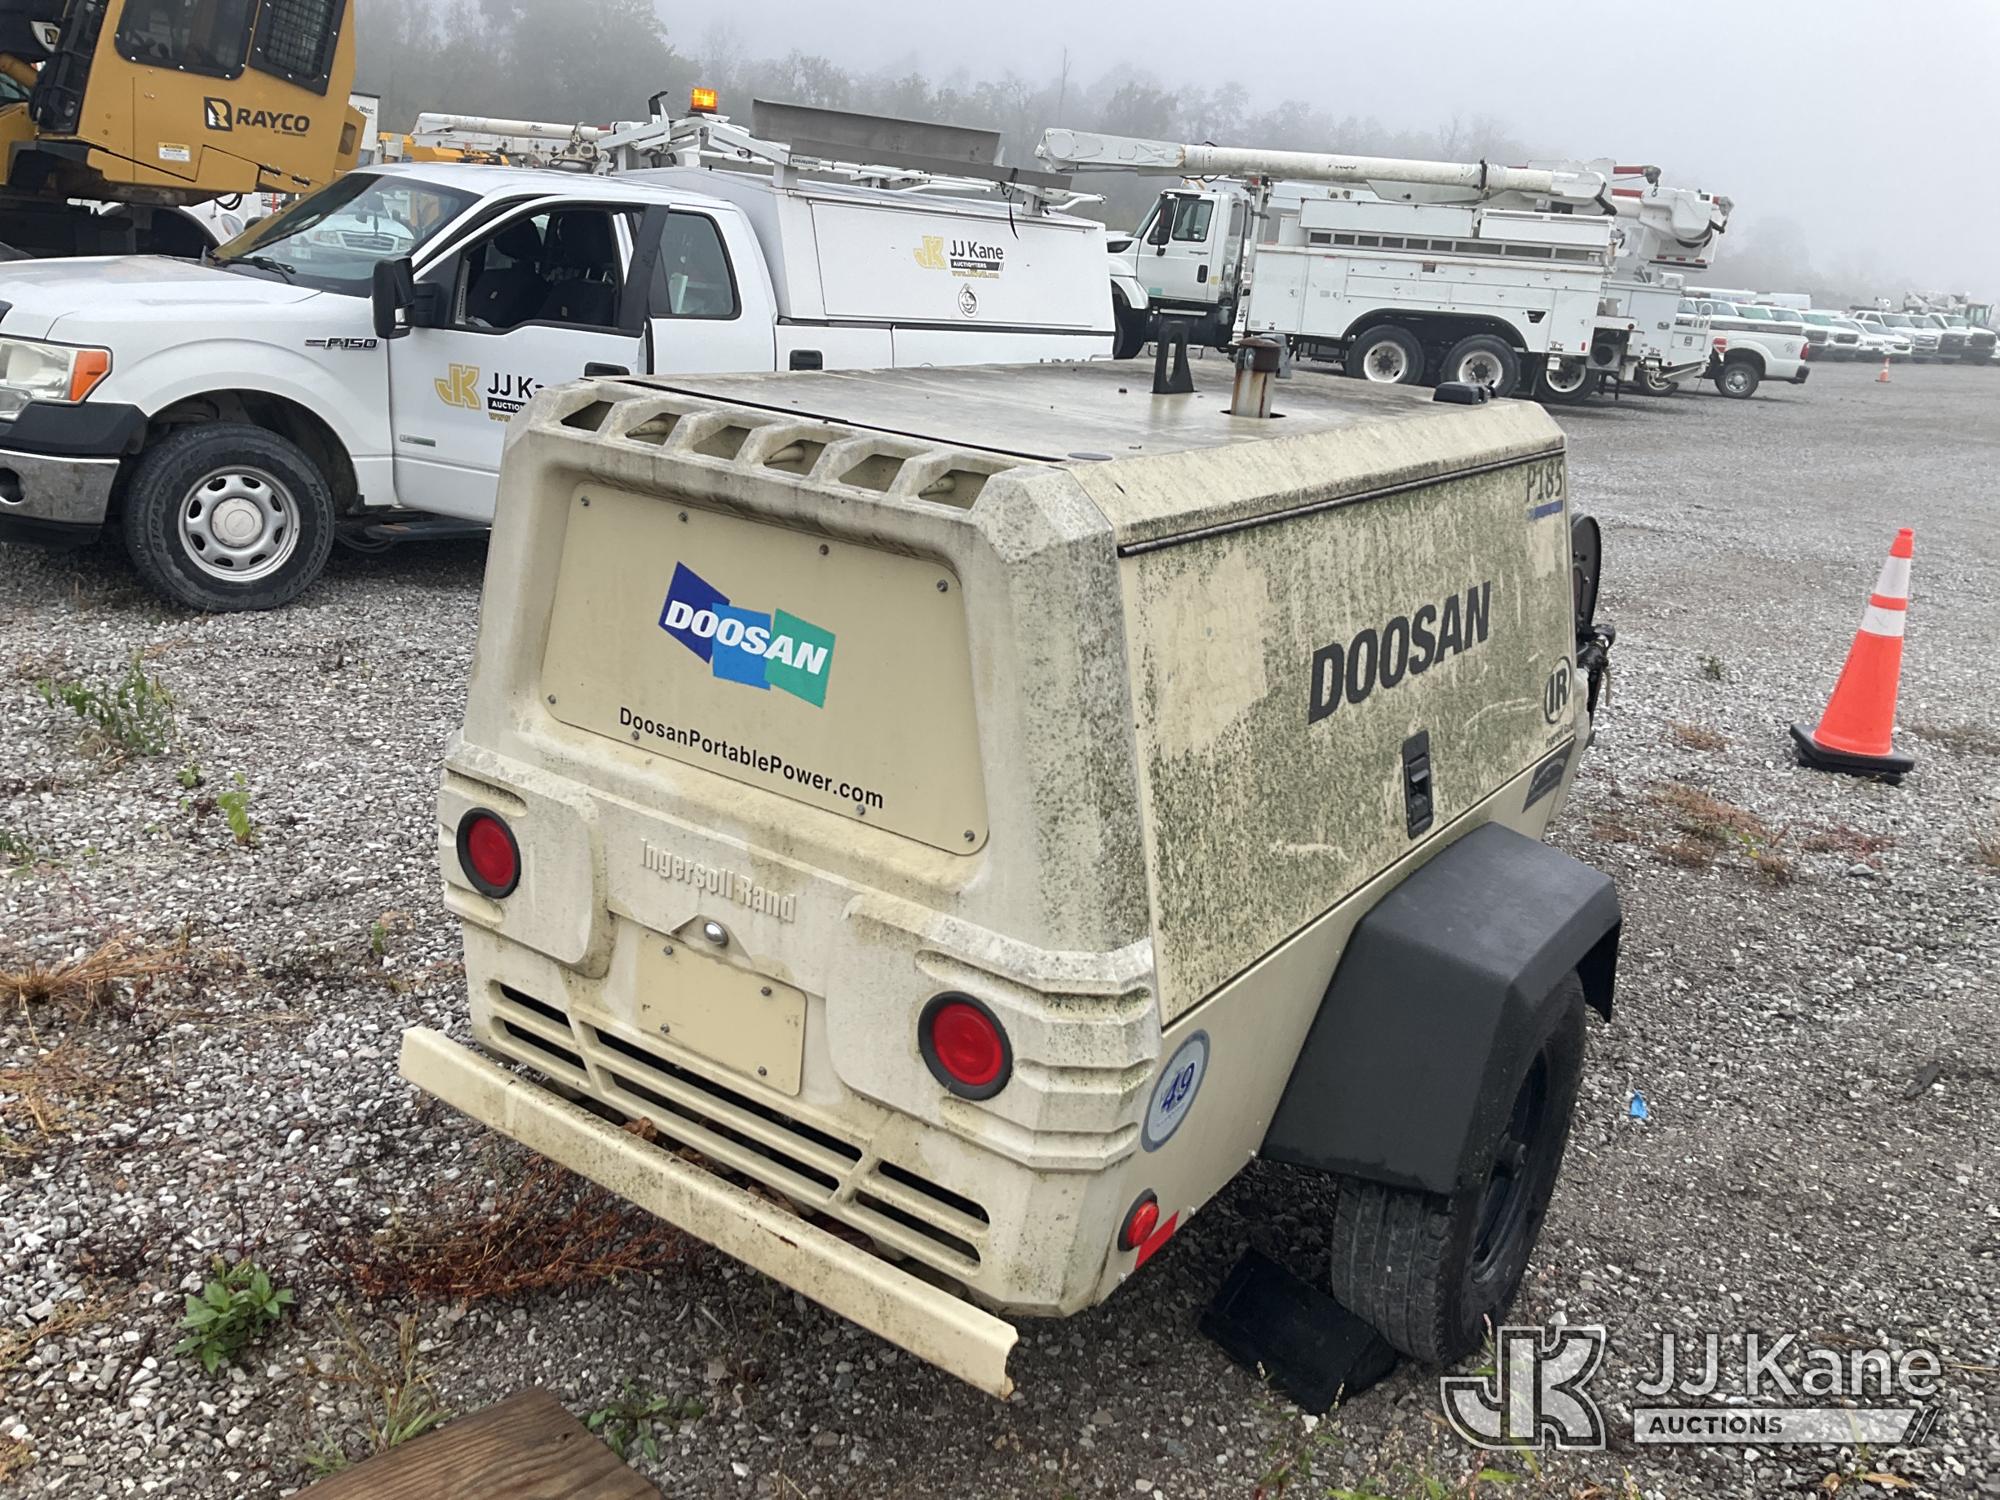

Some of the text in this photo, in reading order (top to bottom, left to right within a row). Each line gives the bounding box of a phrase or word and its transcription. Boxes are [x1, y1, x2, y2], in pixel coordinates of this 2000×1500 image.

[236, 108, 310, 132] RAYCO
[950, 240, 1004, 260] JJ Kane
[487, 372, 511, 397] JJ
[1526, 459, 1563, 502] P185
[664, 600, 828, 676] DOOSAN
[1308, 580, 1491, 726] DOOSAN
[619, 706, 884, 809] DoosanPortablePower.com
[1161, 1062, 1195, 1112] 49
